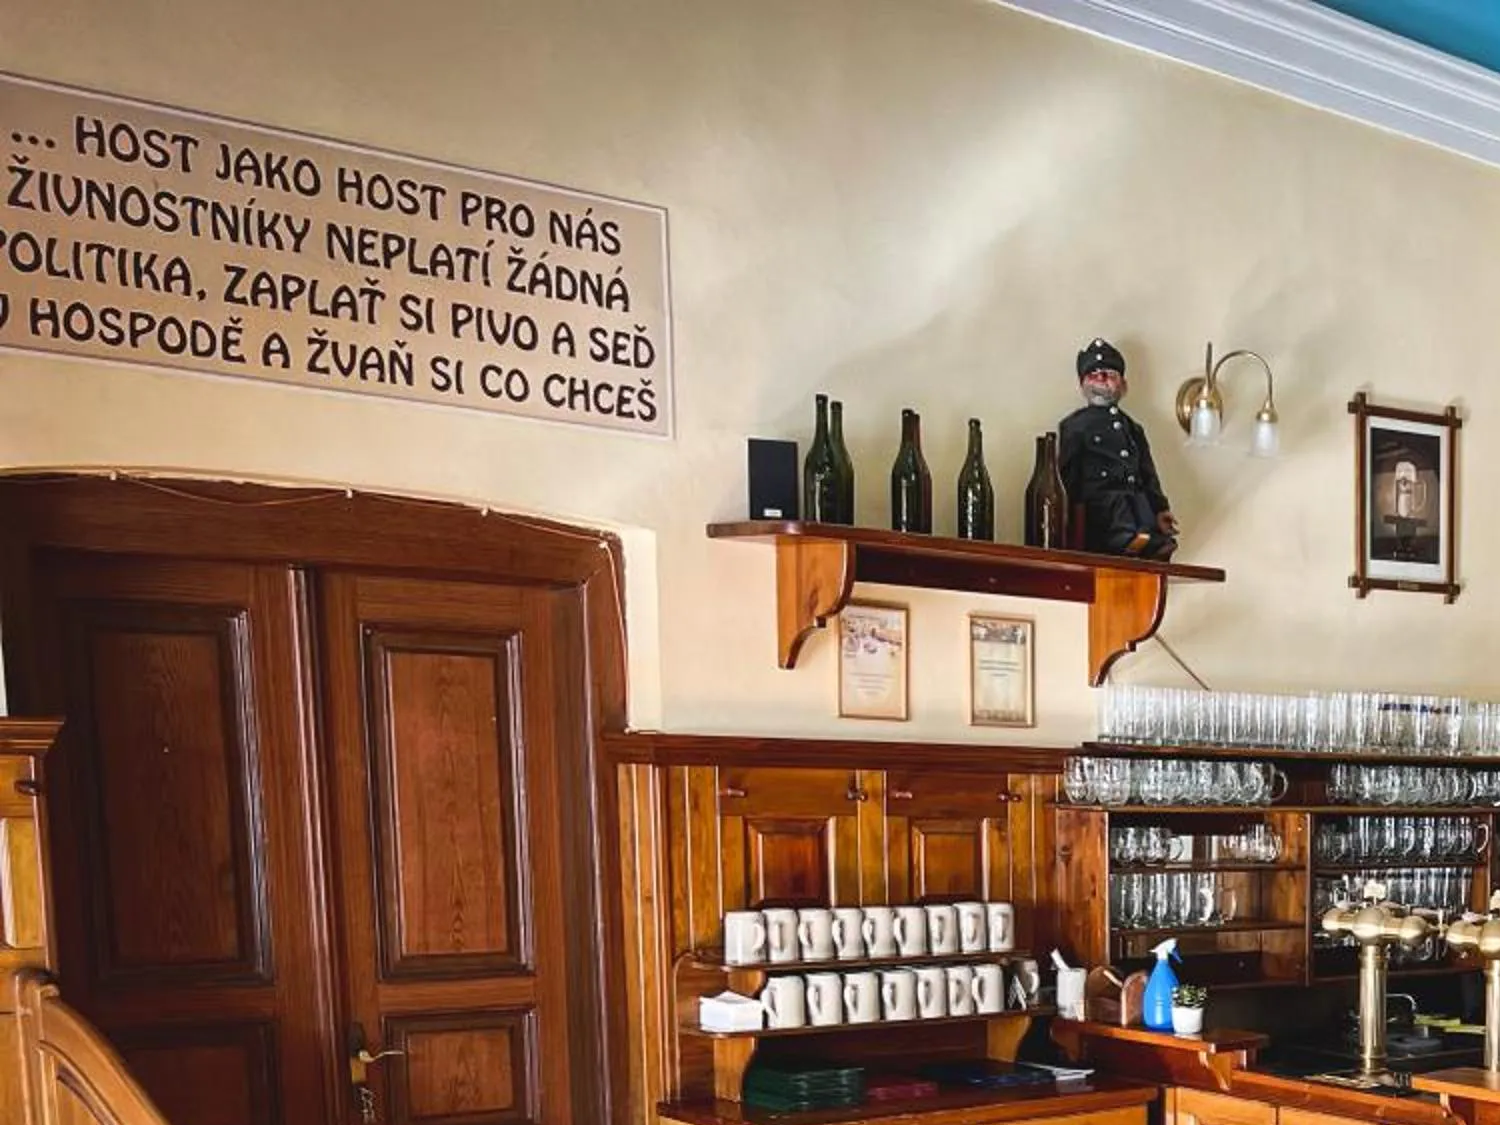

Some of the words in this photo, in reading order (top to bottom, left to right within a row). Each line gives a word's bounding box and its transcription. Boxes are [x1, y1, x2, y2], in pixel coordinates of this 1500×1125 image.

[7, 153, 311, 253] ŽIVNOSTNÍKY
[326, 222, 495, 287] NEPLATÍ
[506, 245, 630, 313] ŽÁDNÁ
[75, 115, 199, 173] HOST
[215, 143, 321, 197] JAKO
[337, 167, 447, 221] HOST
[460, 191, 535, 239] PRO
[549, 208, 622, 255] NÁS
[0, 230, 206, 301] OLITIKA,
[223, 263, 386, 325] ZAPLAŤ
[400, 294, 435, 334] SI
[451, 303, 539, 351] PIVO
[551, 321, 576, 358] A
[588, 324, 655, 369] SEĎ
[29, 297, 246, 364] HOSPODĚ
[261, 331, 291, 369] A
[306, 328, 414, 386] ŽVAŇ
[430, 355, 464, 395] SI
[479, 363, 530, 403] CO
[542, 377, 658, 422] CHCEŠ
